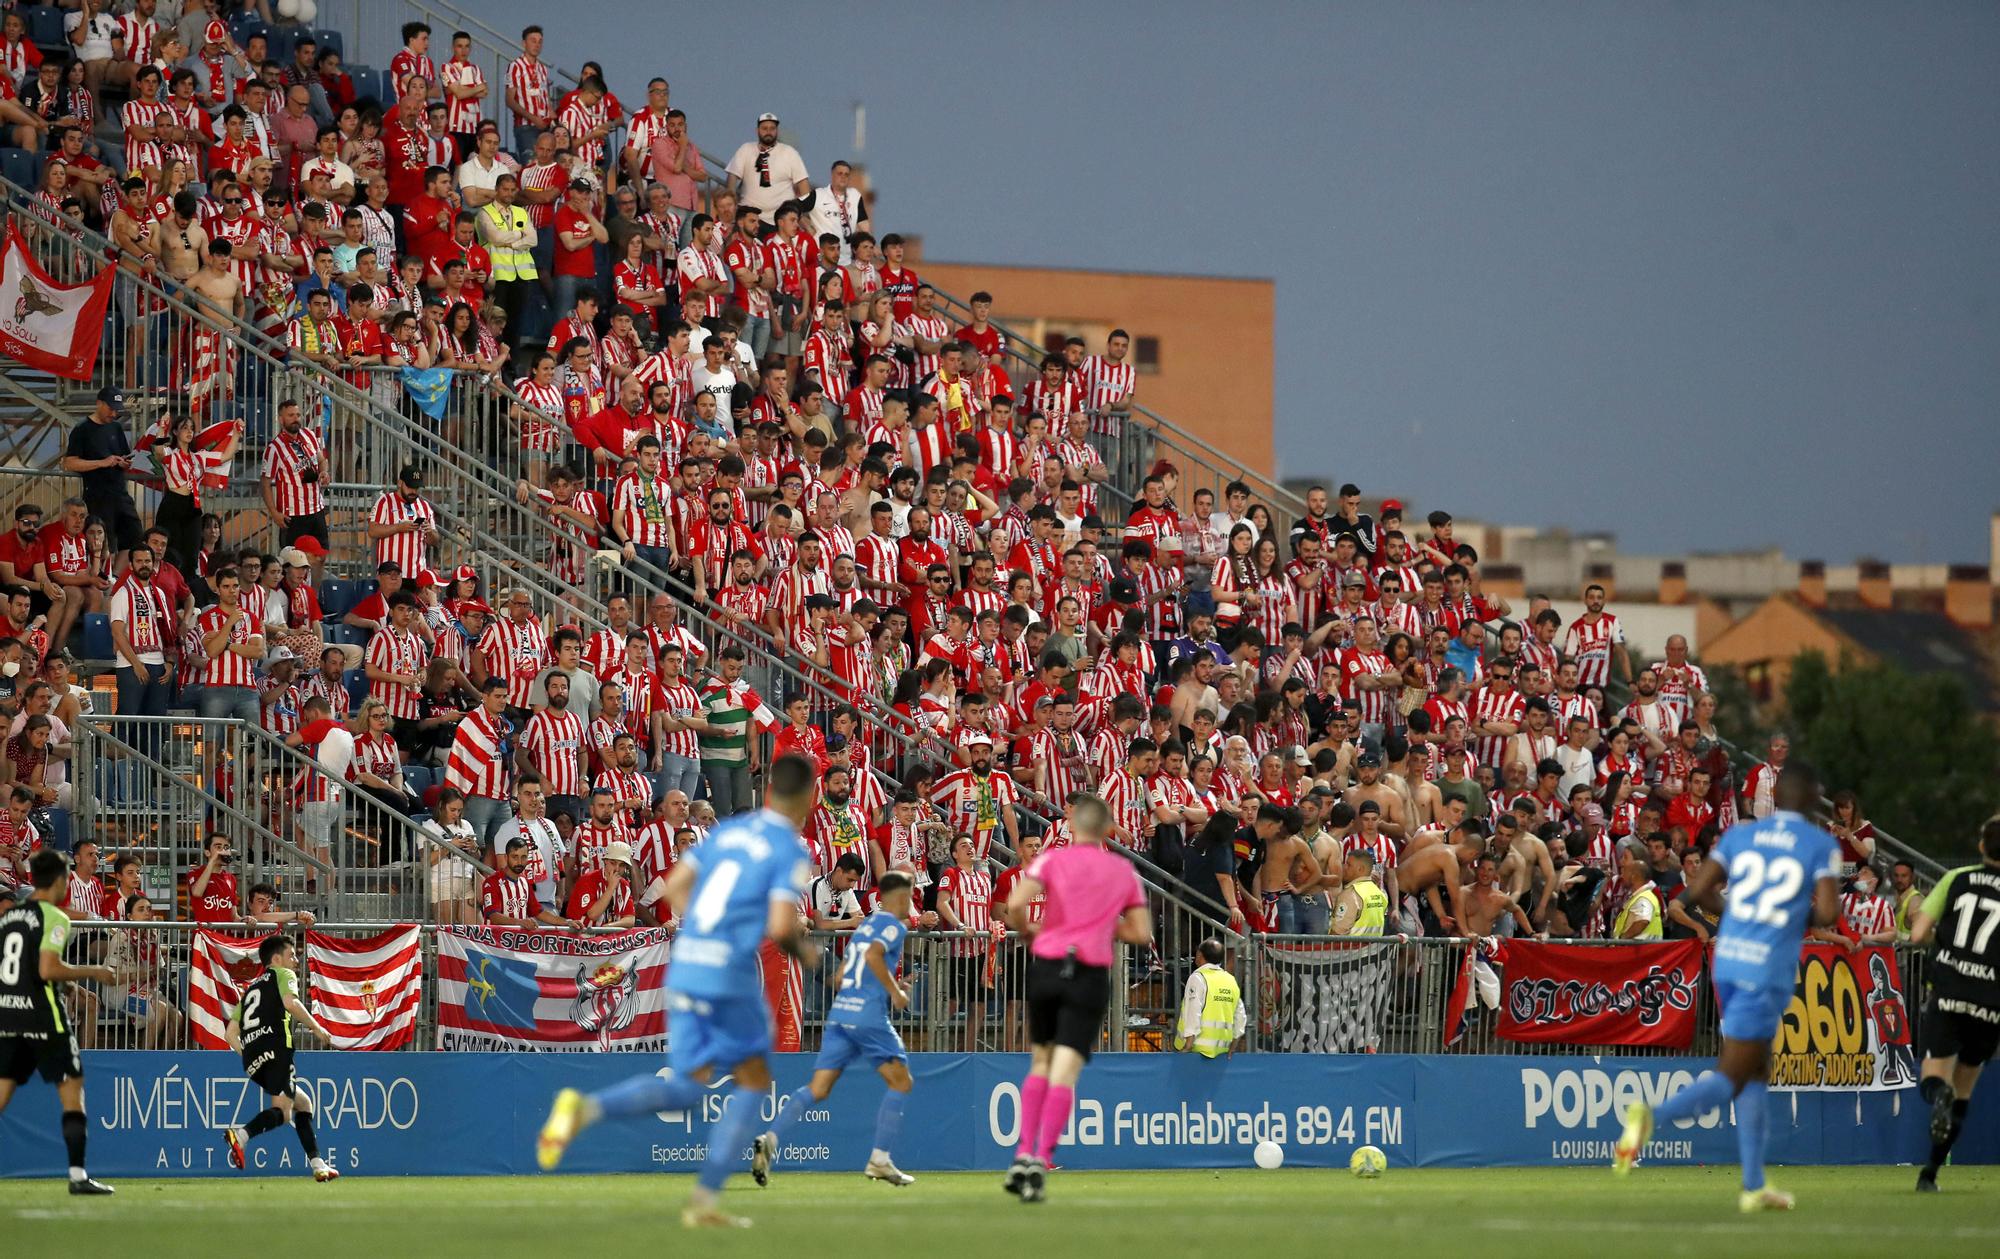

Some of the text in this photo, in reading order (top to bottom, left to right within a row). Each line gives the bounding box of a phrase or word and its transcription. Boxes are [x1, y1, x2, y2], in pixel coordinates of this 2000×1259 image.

[1730, 850, 1804, 928] 22
[501, 927, 669, 955] SPORTINGUISTA
[1953, 892, 2000, 955] 17
[1, 931, 24, 986] 8
[243, 988, 261, 1030] 2
[1769, 1053, 1875, 1086] PORTING ADDICTS
[101, 1064, 250, 1129] JIMÉNEZ
[1114, 1102, 1287, 1145] Fuenlabrada
[1296, 1106, 1355, 1145] 89.4
[1365, 1106, 1402, 1145] FM
[784, 1143, 830, 1164] deporte
[1552, 1140, 1692, 1159] LOUISIAN ITCHEN
